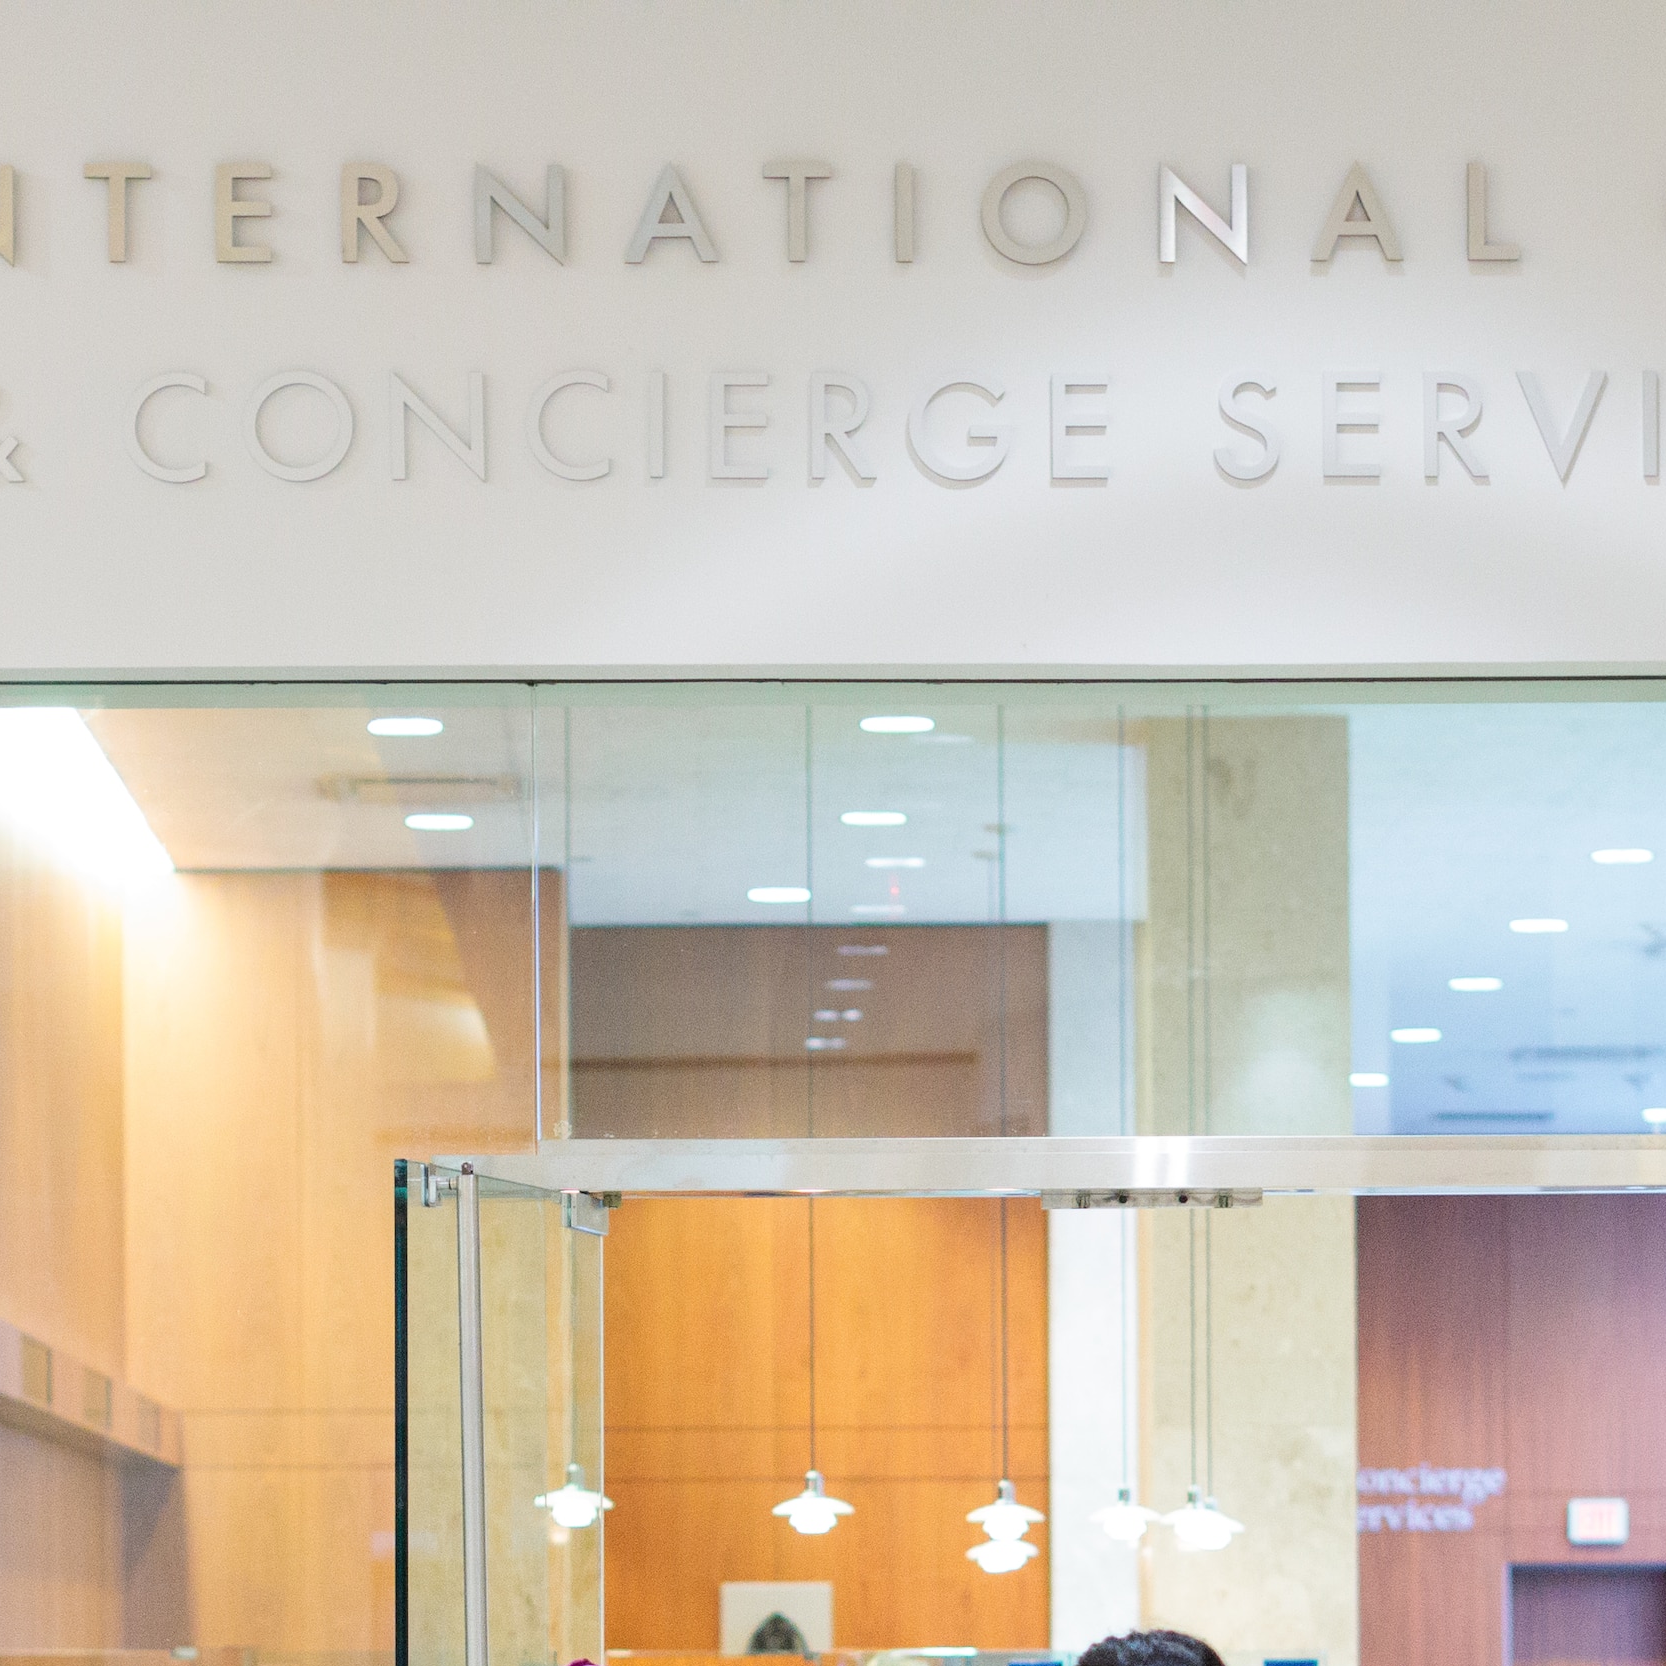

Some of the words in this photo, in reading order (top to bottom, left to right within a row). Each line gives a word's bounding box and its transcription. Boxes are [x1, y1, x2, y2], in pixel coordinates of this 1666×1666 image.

[132, 369, 1111, 485] CONCIERGE
[1356, 1461, 1507, 1504] oncierge
[1356, 1499, 1474, 1531] ervices
